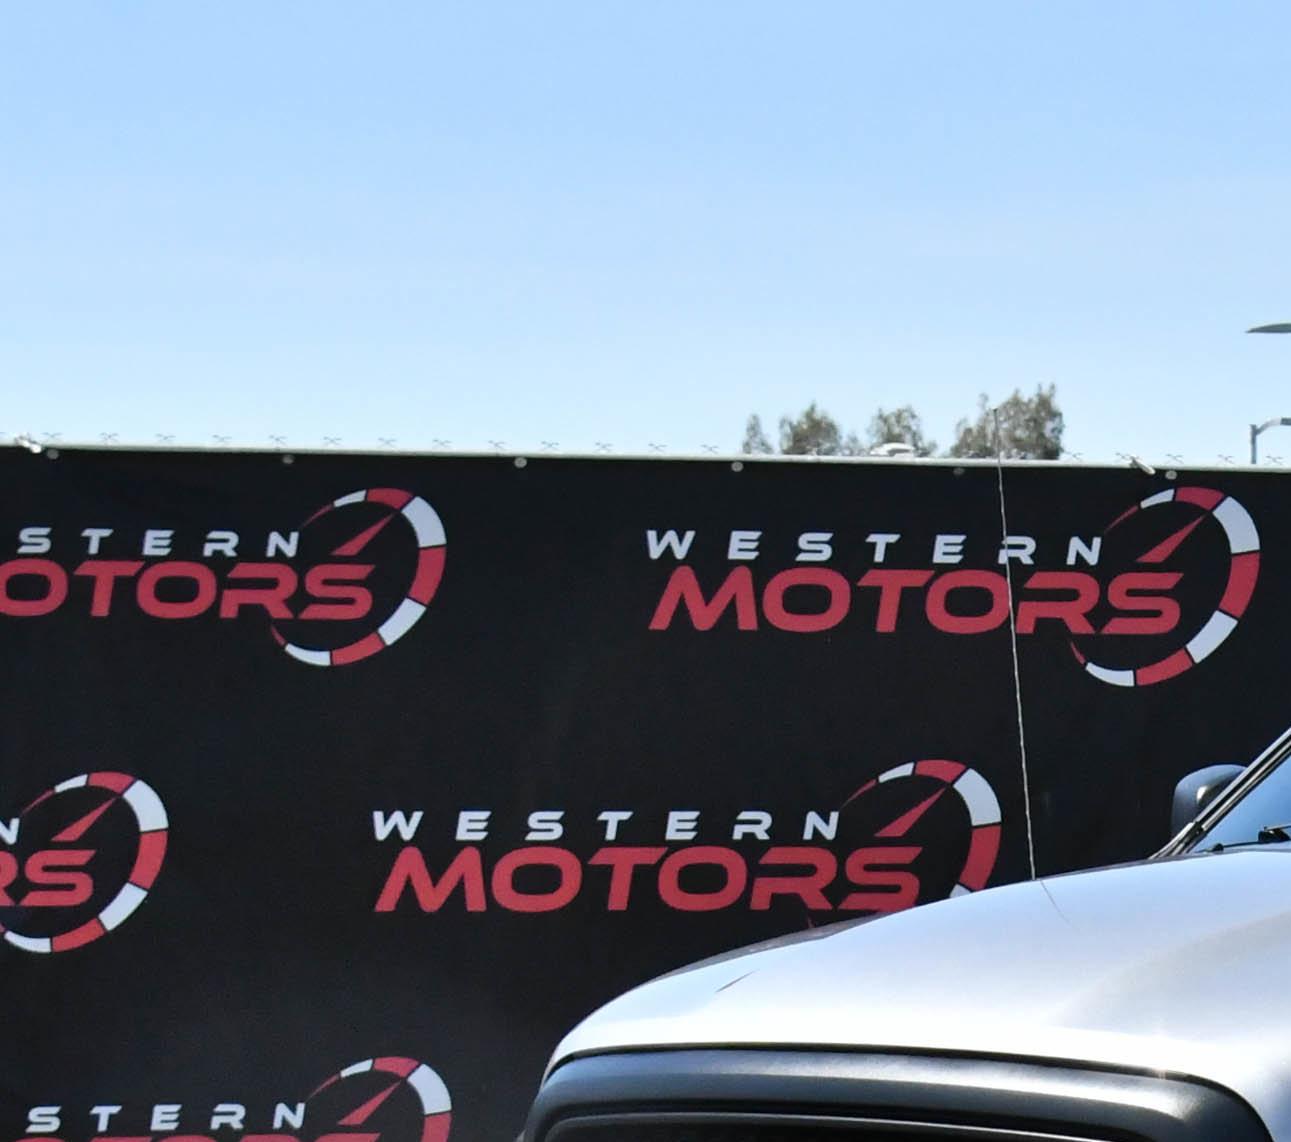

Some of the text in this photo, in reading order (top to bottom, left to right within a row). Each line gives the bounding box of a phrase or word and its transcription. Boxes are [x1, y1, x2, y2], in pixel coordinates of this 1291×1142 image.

[647, 529, 1101, 566] WESTERN
[649, 565, 1184, 634] MOTORS
[373, 811, 840, 840] WESTERN
[375, 846, 922, 912] MOTORS
